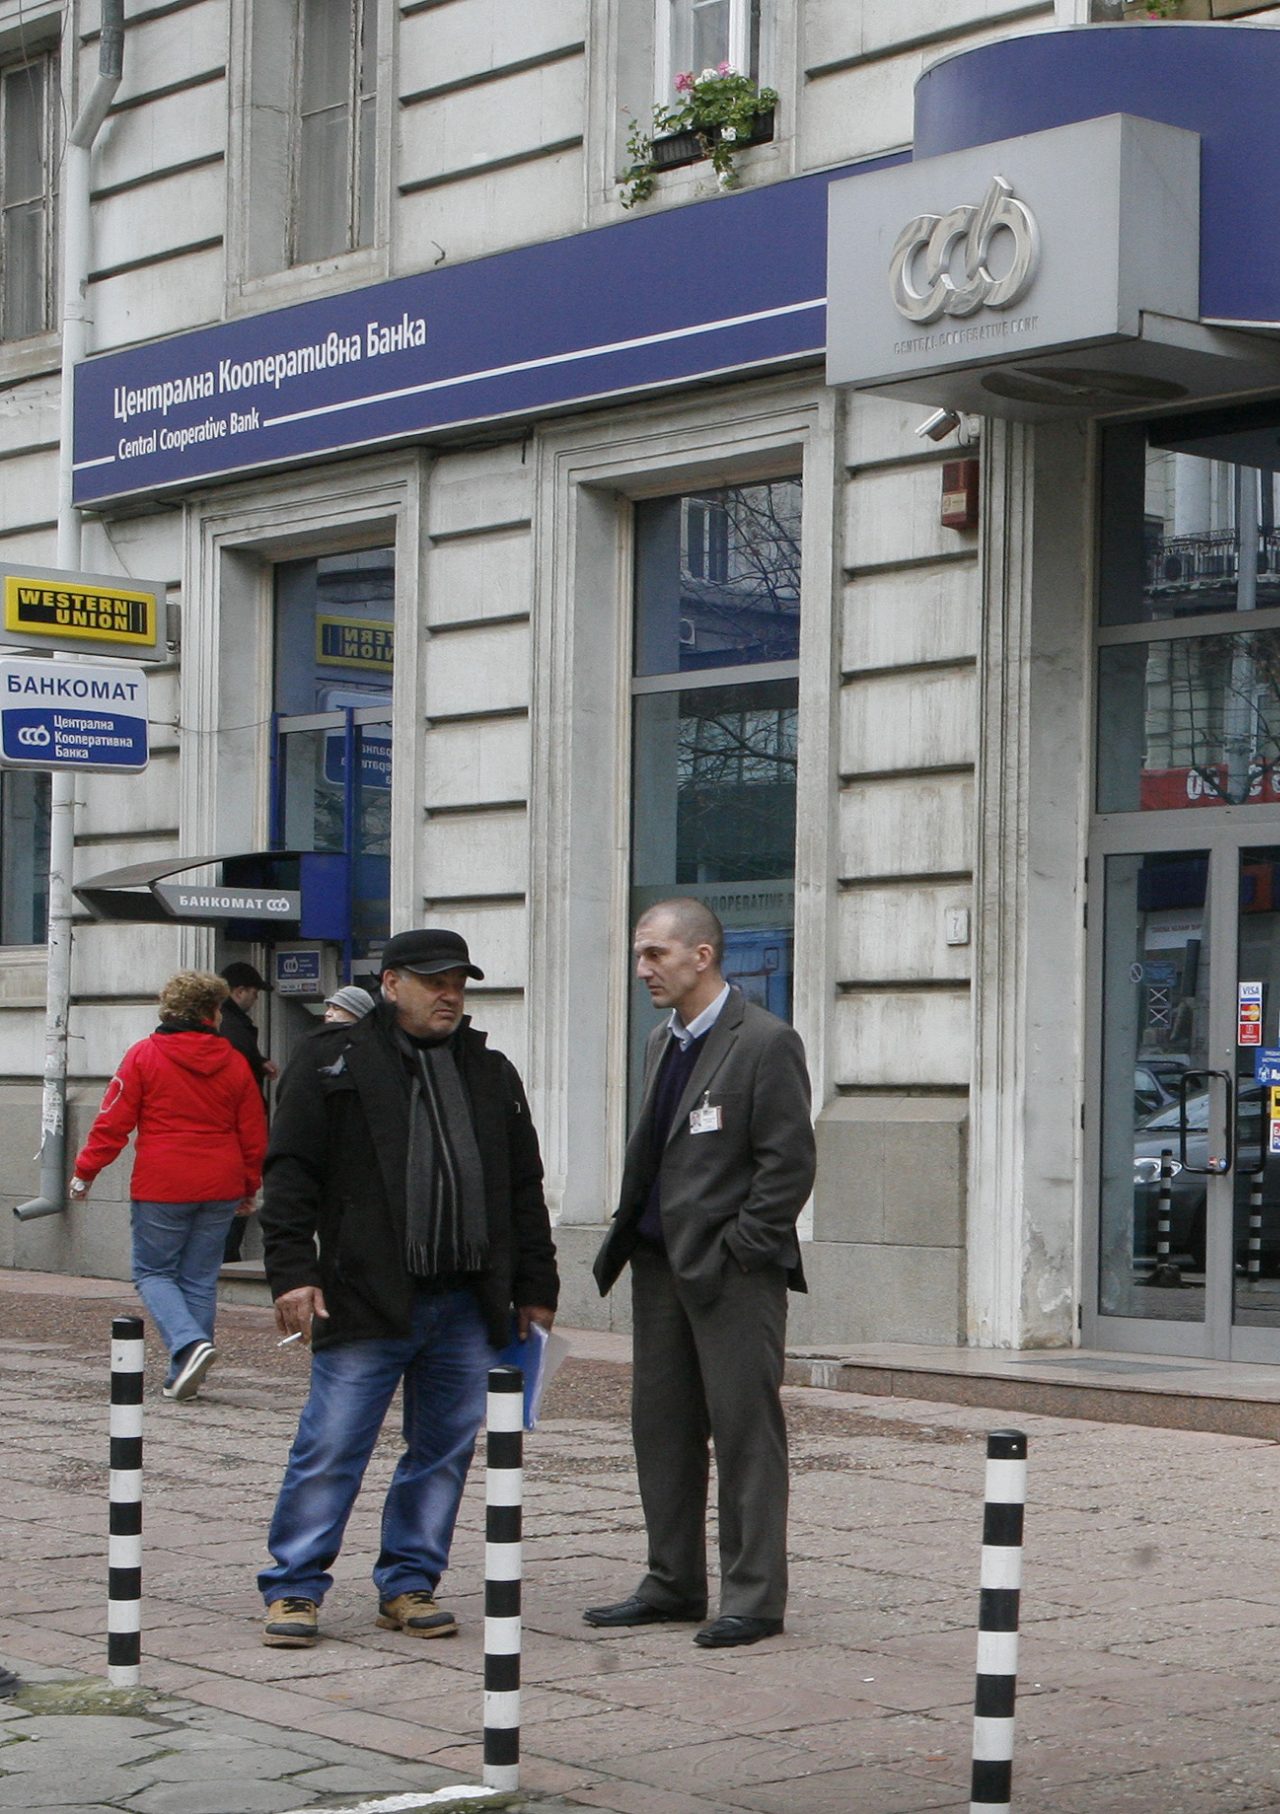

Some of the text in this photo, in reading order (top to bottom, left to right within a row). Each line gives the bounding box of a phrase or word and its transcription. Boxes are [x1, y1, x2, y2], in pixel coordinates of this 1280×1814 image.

[894, 315, 1039, 355] CENTRAL COOPERATIVE BANK
[114, 313, 426, 422] Централна Кооперативна Банка
[118, 407, 260, 460] Central Cooperative Bank
[19, 589, 128, 615] WESTERN
[56, 609, 128, 631] UNION
[7, 675, 138, 701] БАНКОМАТ
[53, 715, 114, 731] Централна
[54, 731, 133, 747] Кооперативна
[55, 746, 89, 759] Банка
[179, 895, 263, 910] БАНКОМАТ
[1243, 986, 1260, 994] VISA
